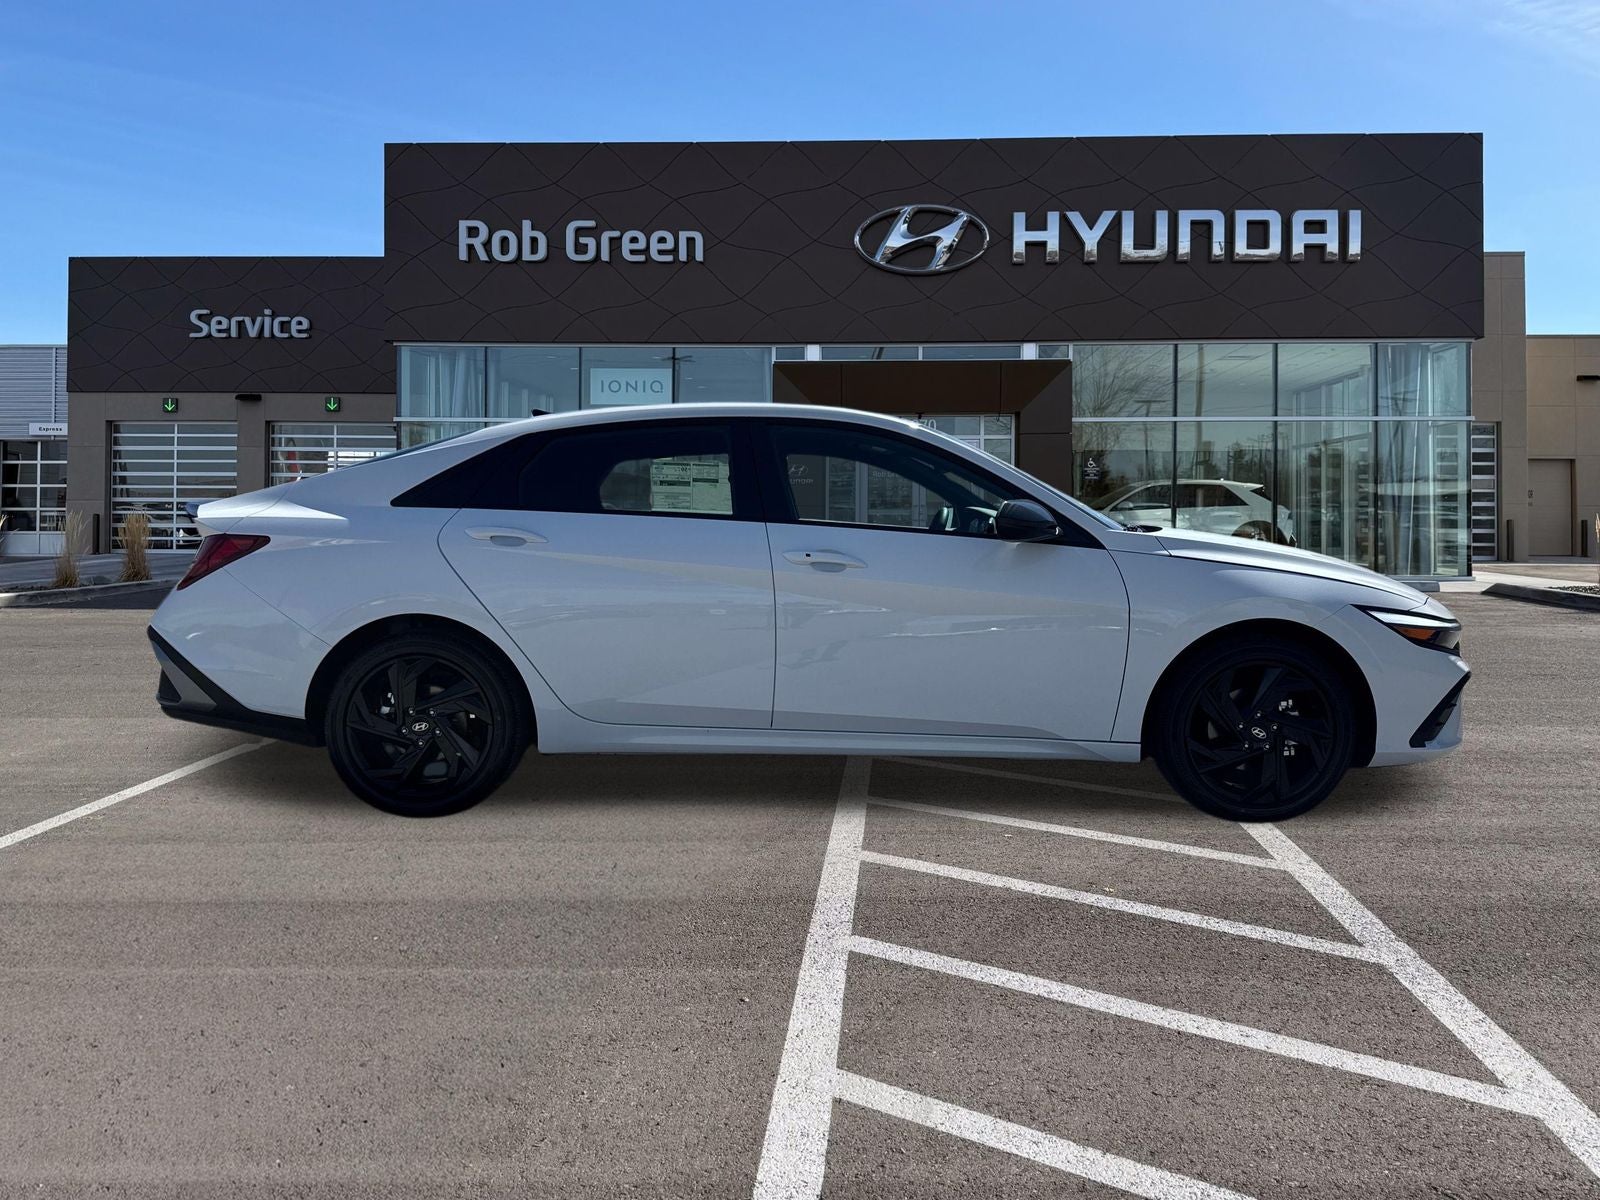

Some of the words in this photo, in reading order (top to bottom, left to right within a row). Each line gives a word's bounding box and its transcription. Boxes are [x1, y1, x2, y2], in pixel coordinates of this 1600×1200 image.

[457, 219, 548, 263] Rob
[565, 219, 704, 263] Green
[1011, 208, 1363, 265] HYUNDAI
[189, 308, 311, 339] Service
[600, 380, 664, 394] IONIQ
